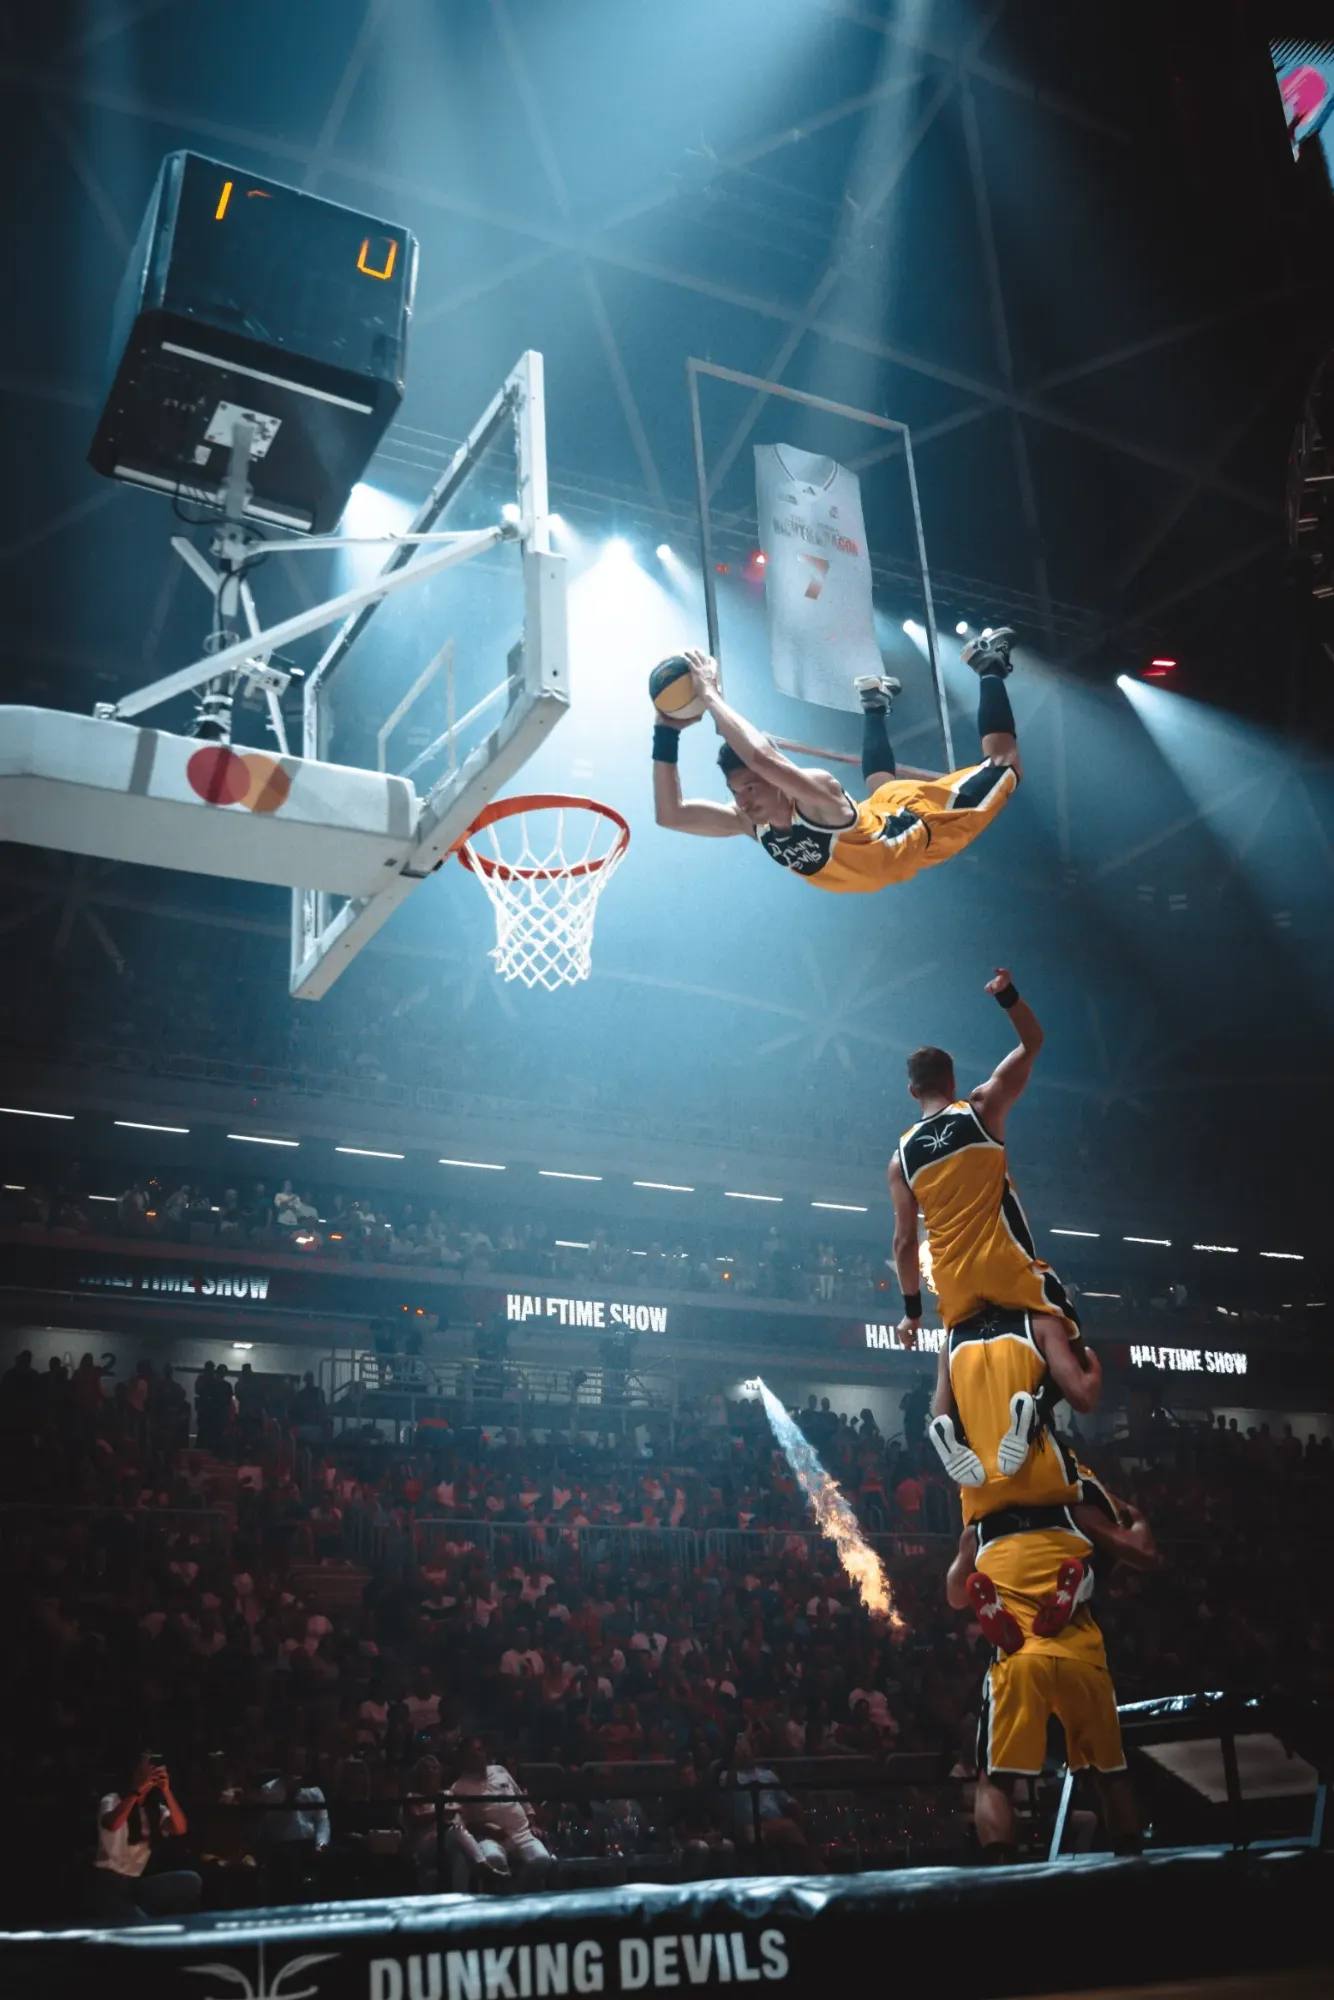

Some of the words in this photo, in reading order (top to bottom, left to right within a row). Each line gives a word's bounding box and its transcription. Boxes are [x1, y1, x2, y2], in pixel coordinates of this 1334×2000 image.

[506, 1294, 606, 1328] HALFTIME
[609, 1303, 667, 1333] SHOW
[865, 1323, 948, 1353] HALIM
[1129, 1344, 1204, 1371] HALFTIME
[1205, 1350, 1247, 1375] SHOW
[368, 1939, 604, 2000] DUNKING
[619, 1929, 789, 1990] DEVILS
